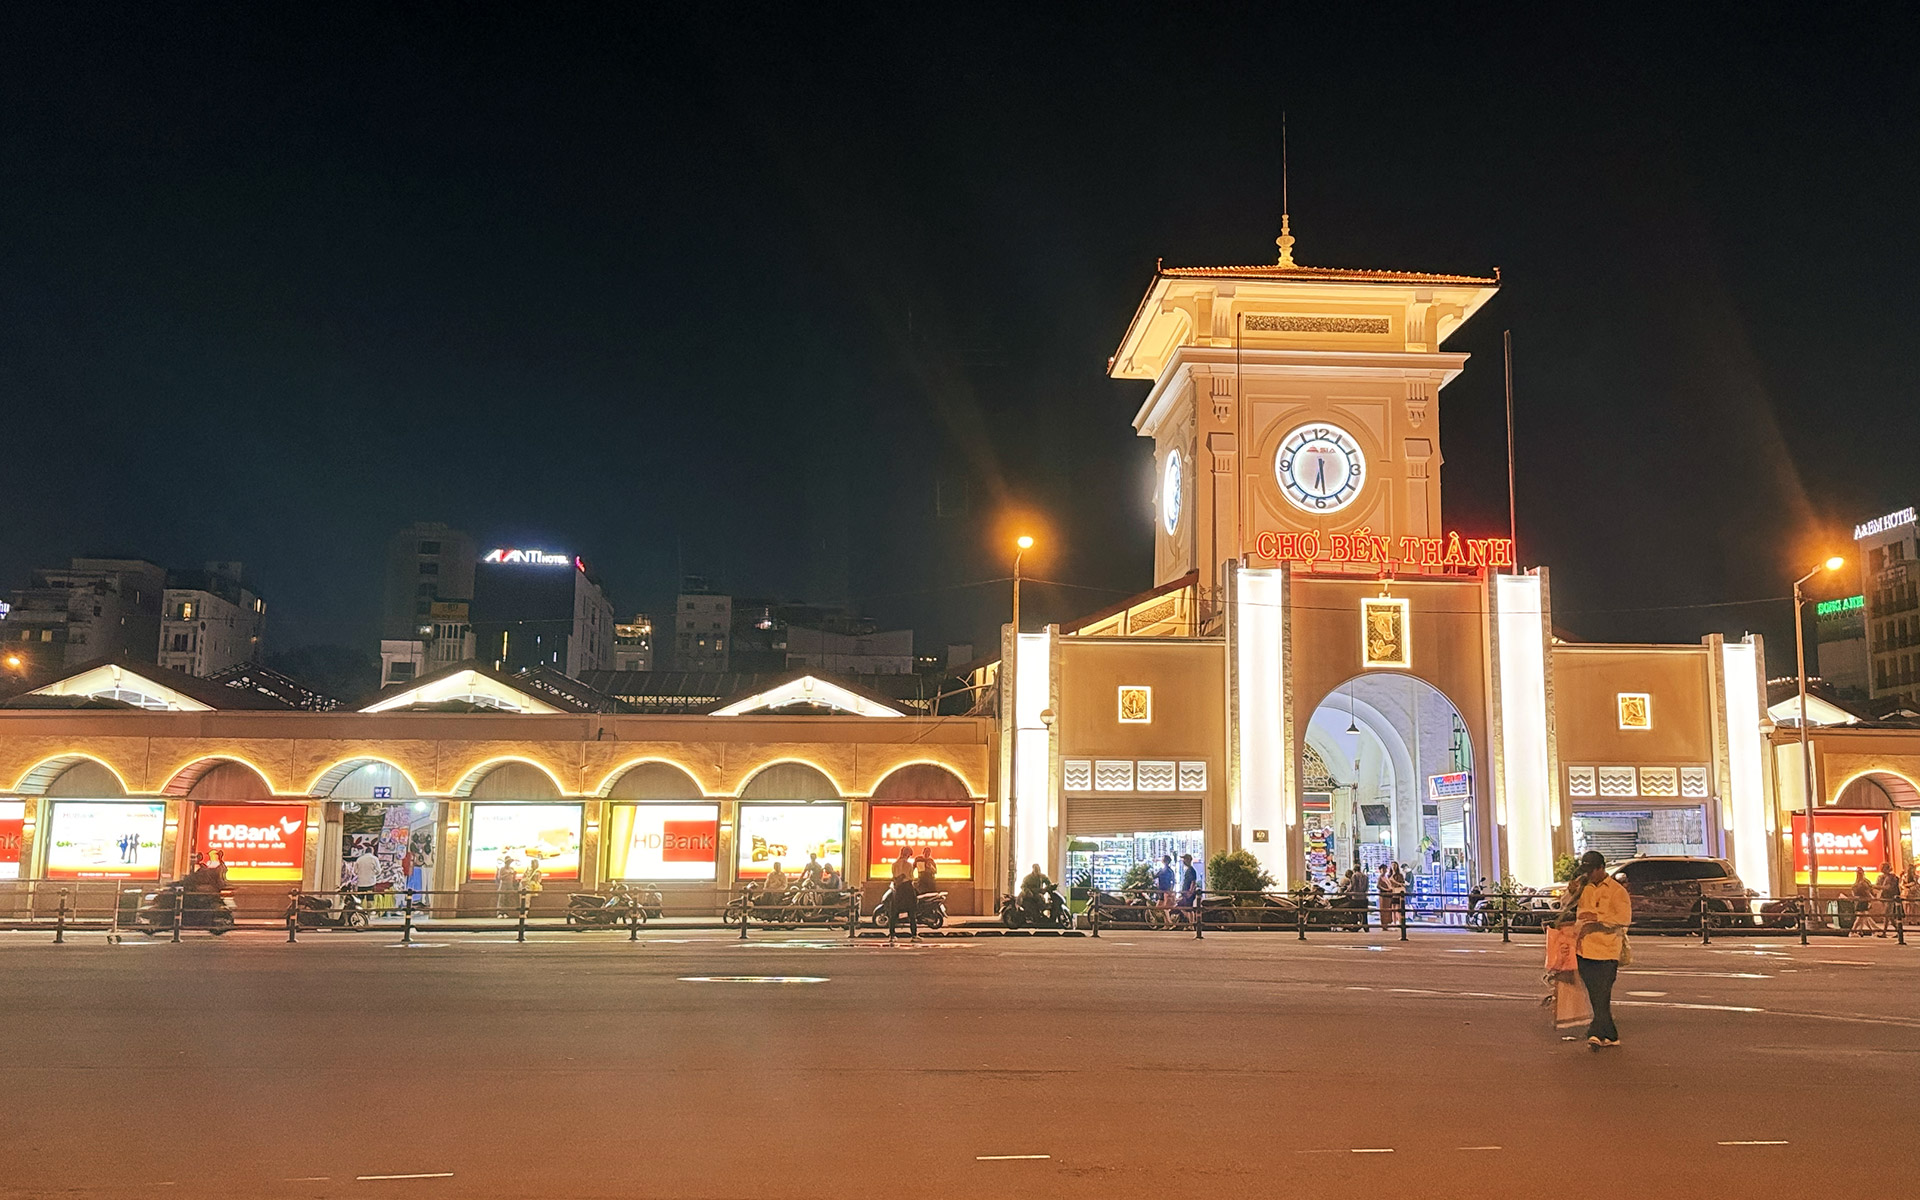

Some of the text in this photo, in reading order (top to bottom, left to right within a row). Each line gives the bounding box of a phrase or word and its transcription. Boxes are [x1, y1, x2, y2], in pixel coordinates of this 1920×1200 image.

[1312, 428, 1330, 440] 12
[1279, 459, 1291, 472] 9
[1350, 463, 1361, 476] 3
[1315, 498, 1326, 509] 6
[1883, 507, 1916, 530] HOTEL
[1256, 527, 1512, 566] CHỢ BẾN THÀNH
[484, 549, 569, 564] AVANTI HOTEL
[384, 788, 390, 798] 2
[208, 824, 281, 841] HDBank
[881, 823, 948, 839] HDBank
[633, 833, 713, 850] HDBank
